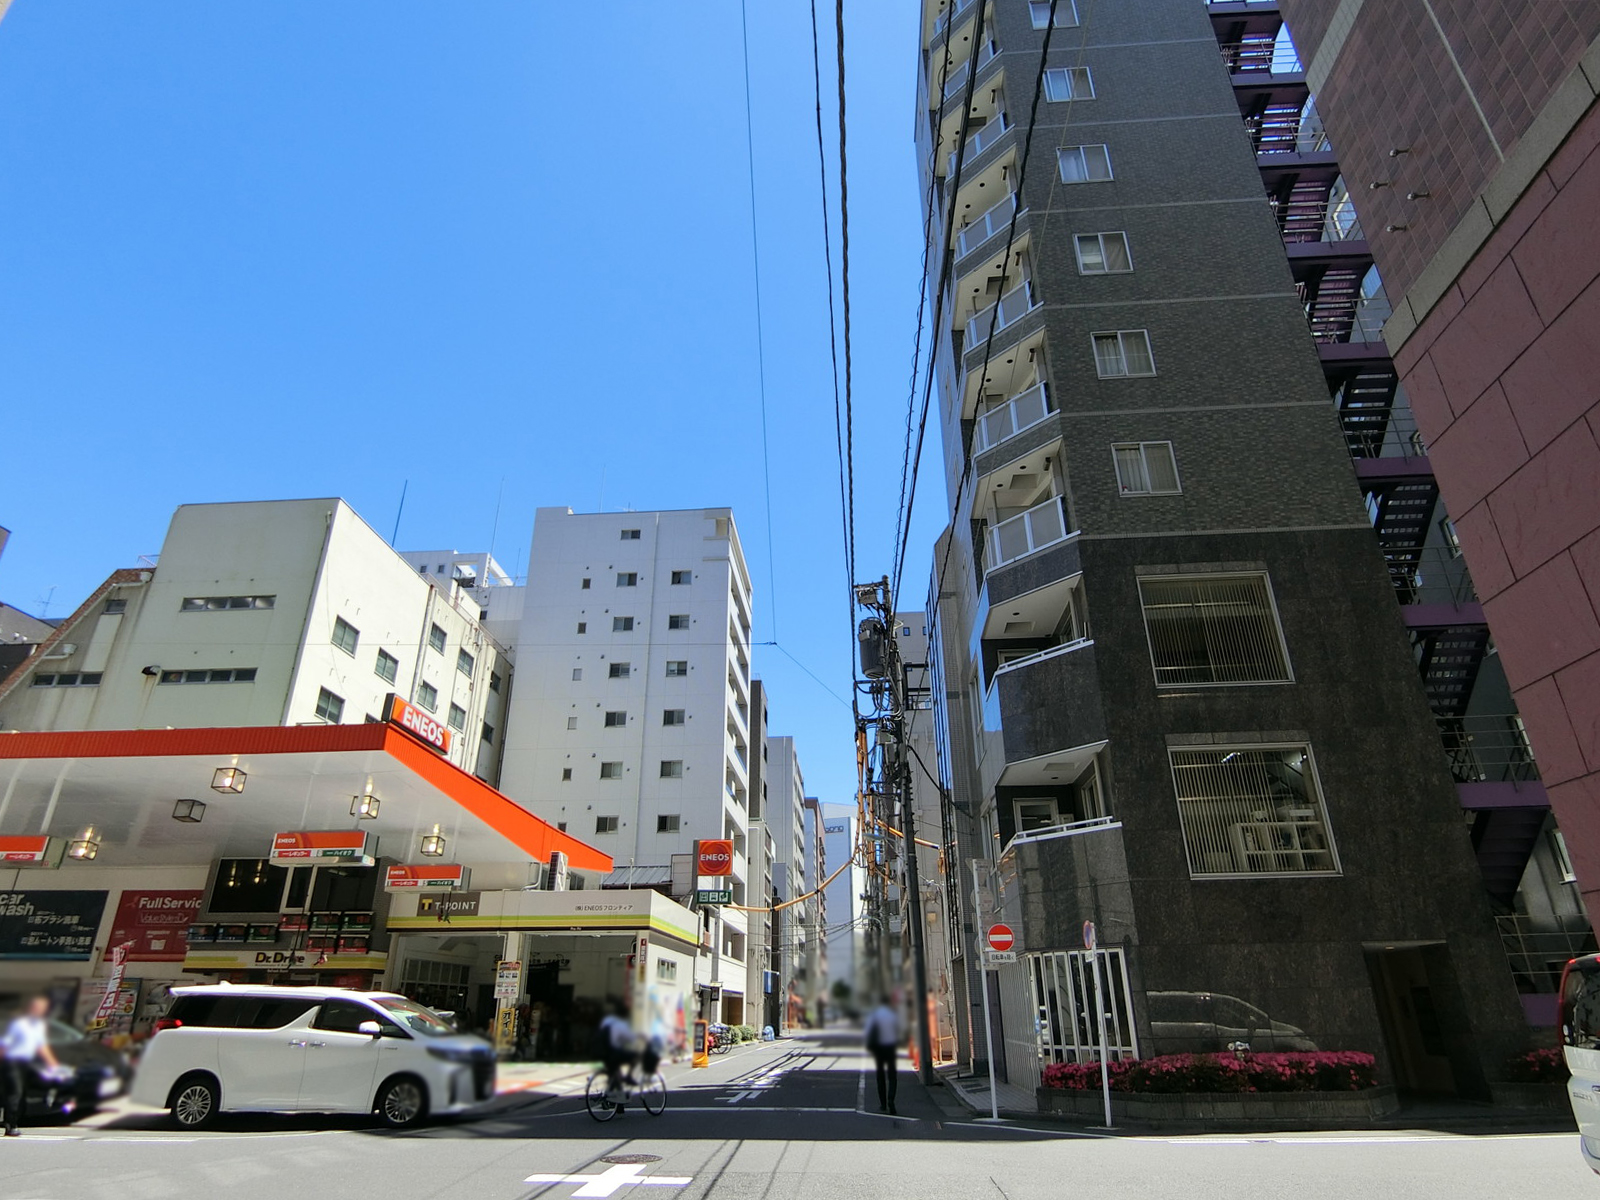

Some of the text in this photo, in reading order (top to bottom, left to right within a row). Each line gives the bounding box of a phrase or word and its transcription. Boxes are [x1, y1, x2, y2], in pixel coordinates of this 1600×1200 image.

[402, 705, 444, 747] ENEOS
[700, 853, 730, 861] ENEOS
[0, 893, 25, 905] car
[434, 901, 477, 911] T-POINT
